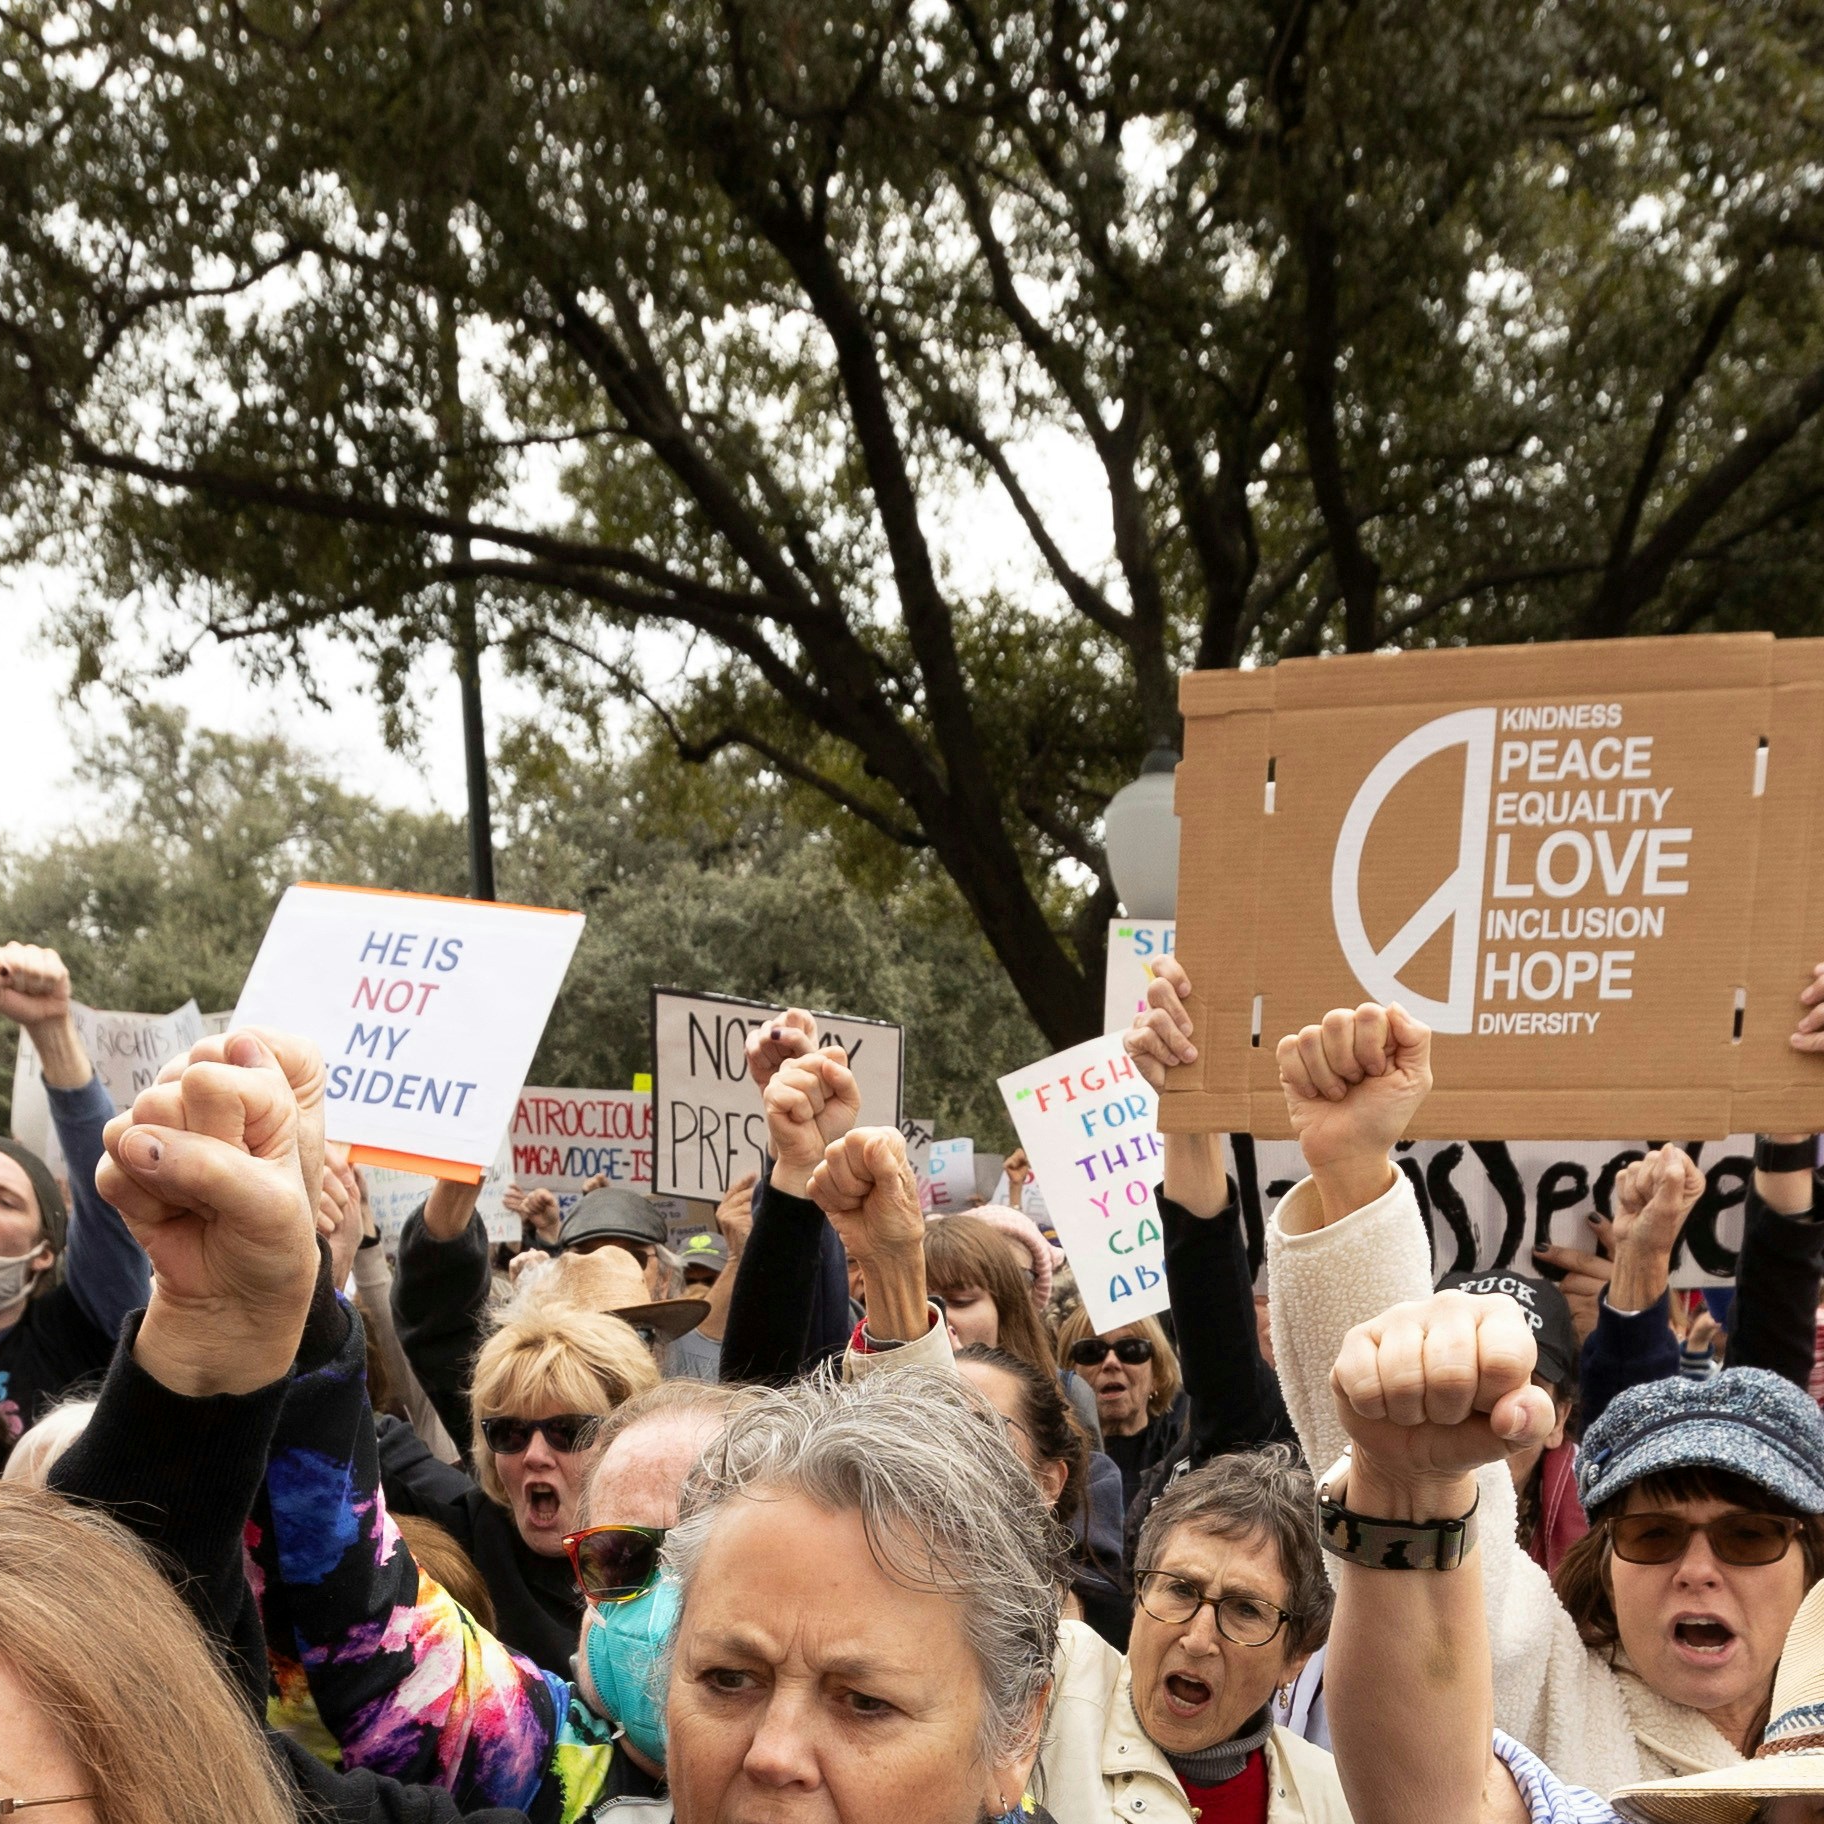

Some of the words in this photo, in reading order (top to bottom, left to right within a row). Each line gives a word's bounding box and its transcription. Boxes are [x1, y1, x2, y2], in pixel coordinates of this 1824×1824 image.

[1502, 704, 1623, 731] KINDNESS
[1499, 736, 1654, 783] PEACE
[1495, 787, 1674, 826] EQUALITY
[1493, 827, 1693, 899] LOVE
[1485, 904, 1665, 941] INCLUSION
[359, 930, 418, 966] HE
[422, 937, 464, 972] IS
[1483, 950, 1636, 1001] HOPE
[351, 976, 440, 1016] NOT
[345, 1022, 411, 1061] MY
[1477, 1011, 1602, 1036] DIVERSITY
[325, 1063, 477, 1117] SIDENT
[899, 1119, 934, 1149] OFF
[1080, 1094, 1149, 1138] FOR
[1089, 1180, 1149, 1219] YO
